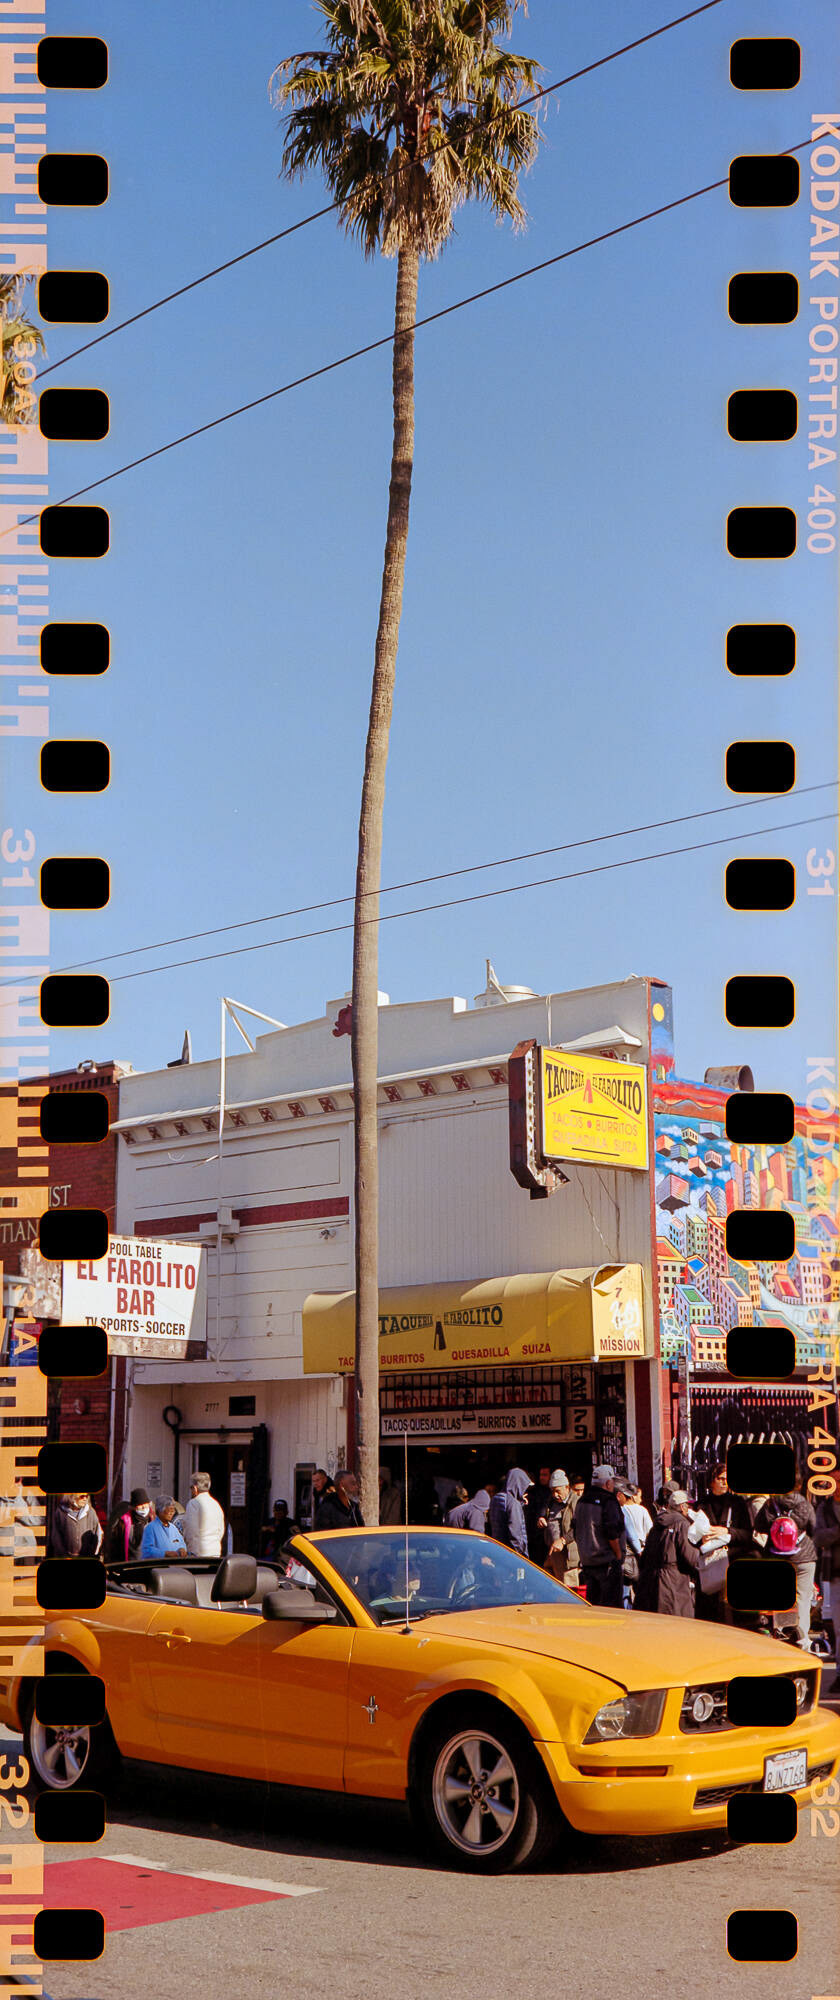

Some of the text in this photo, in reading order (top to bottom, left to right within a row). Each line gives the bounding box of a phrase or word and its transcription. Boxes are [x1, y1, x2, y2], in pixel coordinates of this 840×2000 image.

[545, 1062, 584, 1099] TAQUERIA
[598, 1078, 642, 1115] FAROLITO
[552, 1111, 638, 1136] TACOS BURRITOS
[110, 1242, 162, 1260] POOL TABLE
[77, 1257, 196, 1290] EL FAROLITO
[116, 1288, 155, 1316] BAR
[378, 1315, 433, 1334] TAQUERIA
[450, 1305, 503, 1325] FAROLITO
[380, 1353, 425, 1365] BURRITOS
[451, 1347, 510, 1361] QUESADILLA
[522, 1343, 551, 1355] SUIZA
[383, 1414, 552, 1432] TACOS QUESADILLAS BURRITOS & MORE
